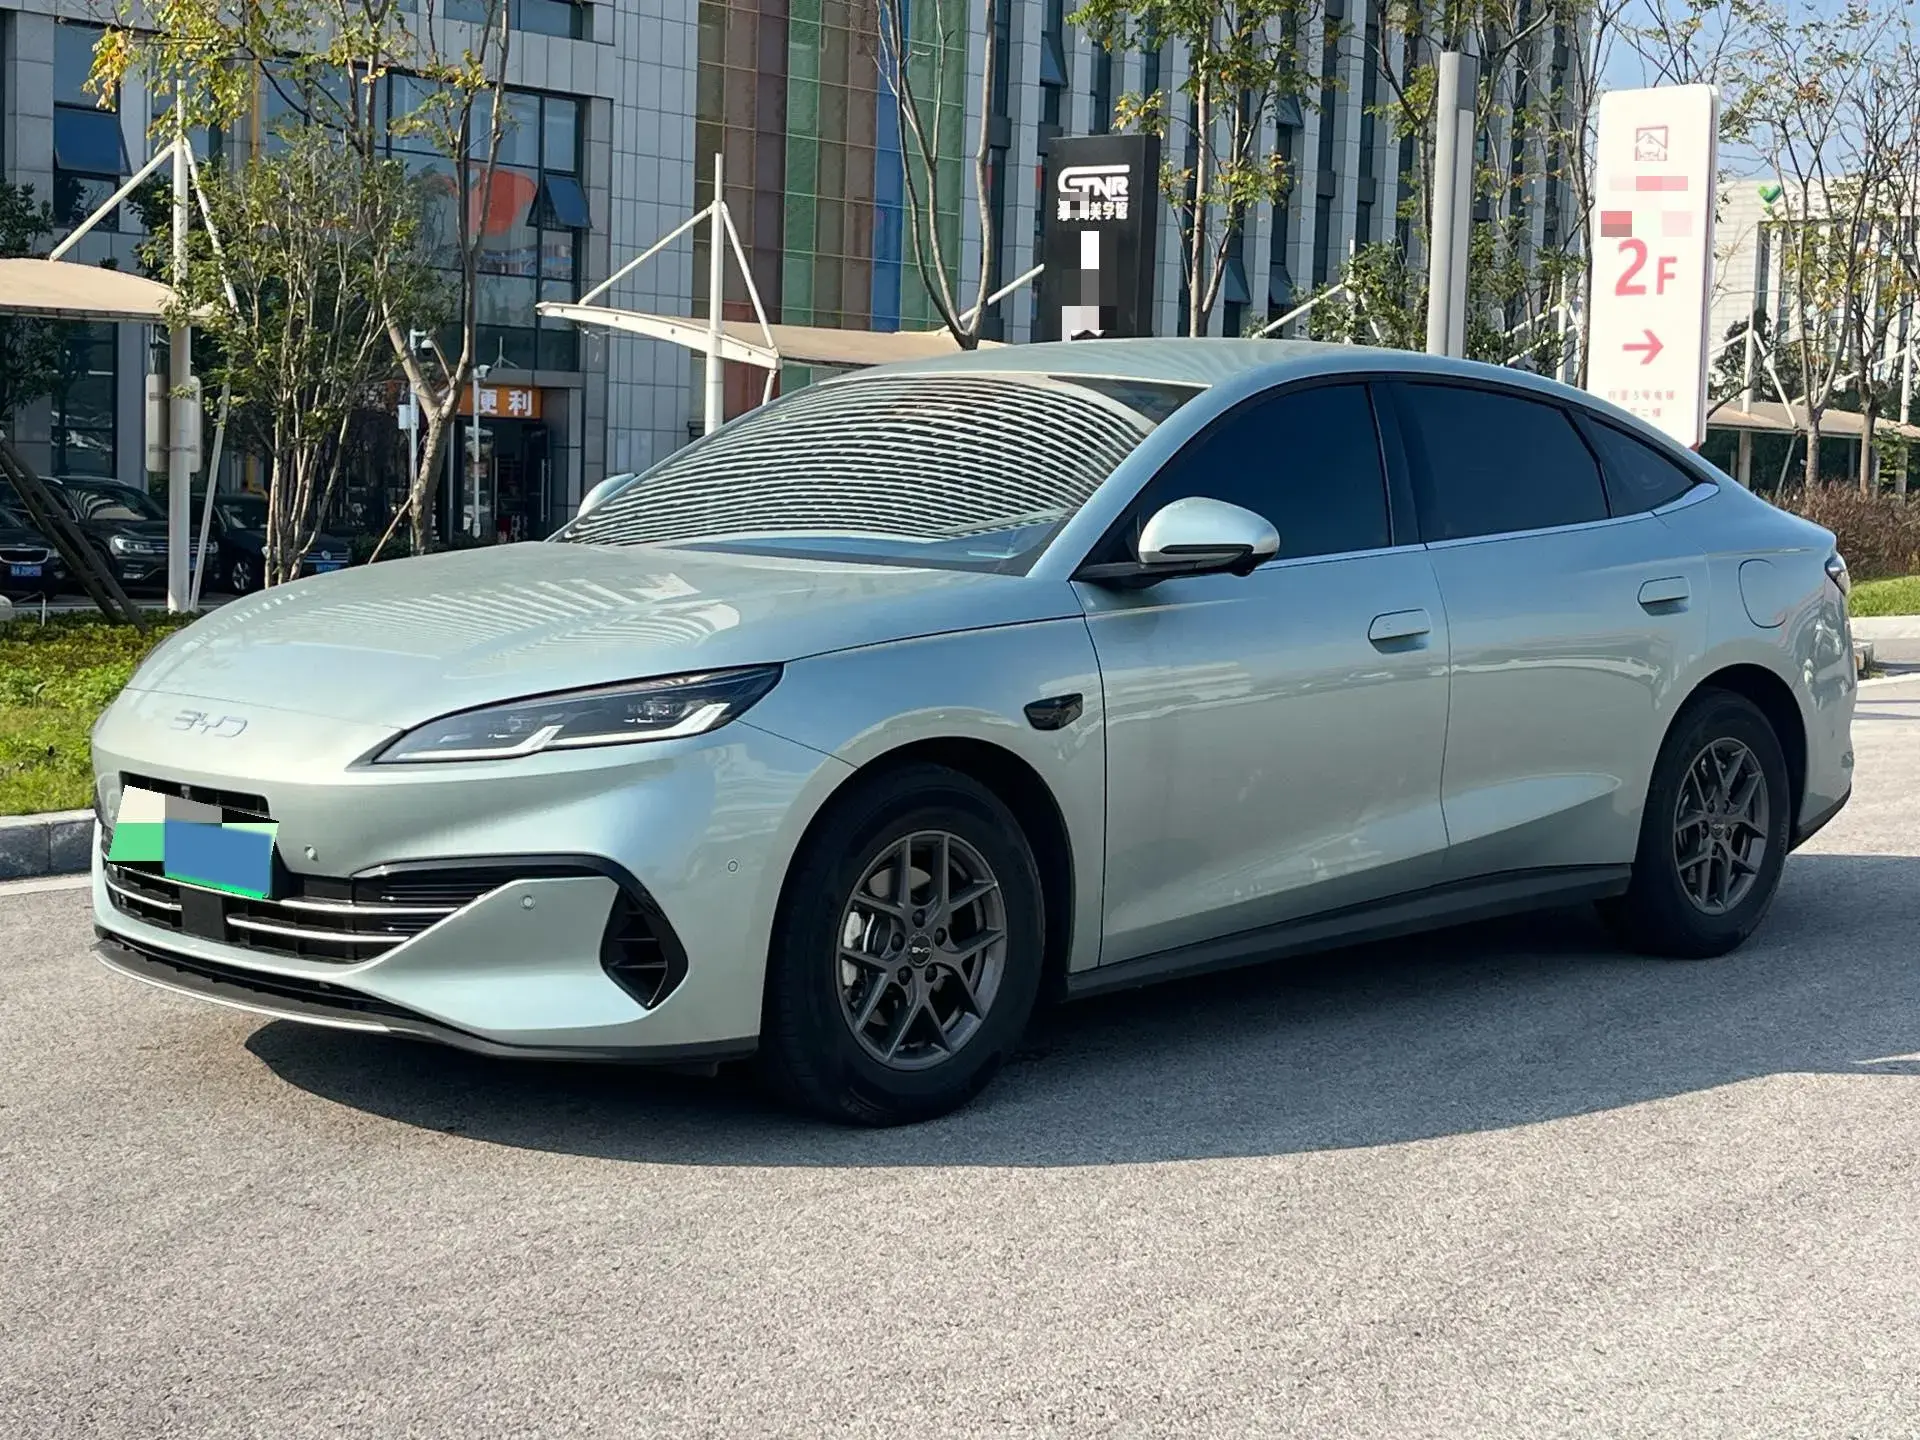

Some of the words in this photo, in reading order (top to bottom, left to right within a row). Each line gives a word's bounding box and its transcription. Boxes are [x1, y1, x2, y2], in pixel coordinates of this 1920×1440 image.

[1057, 201, 1128, 221] 美学馆
[1614, 238, 1677, 296] 2F
[171, 709, 248, 738] BYD
